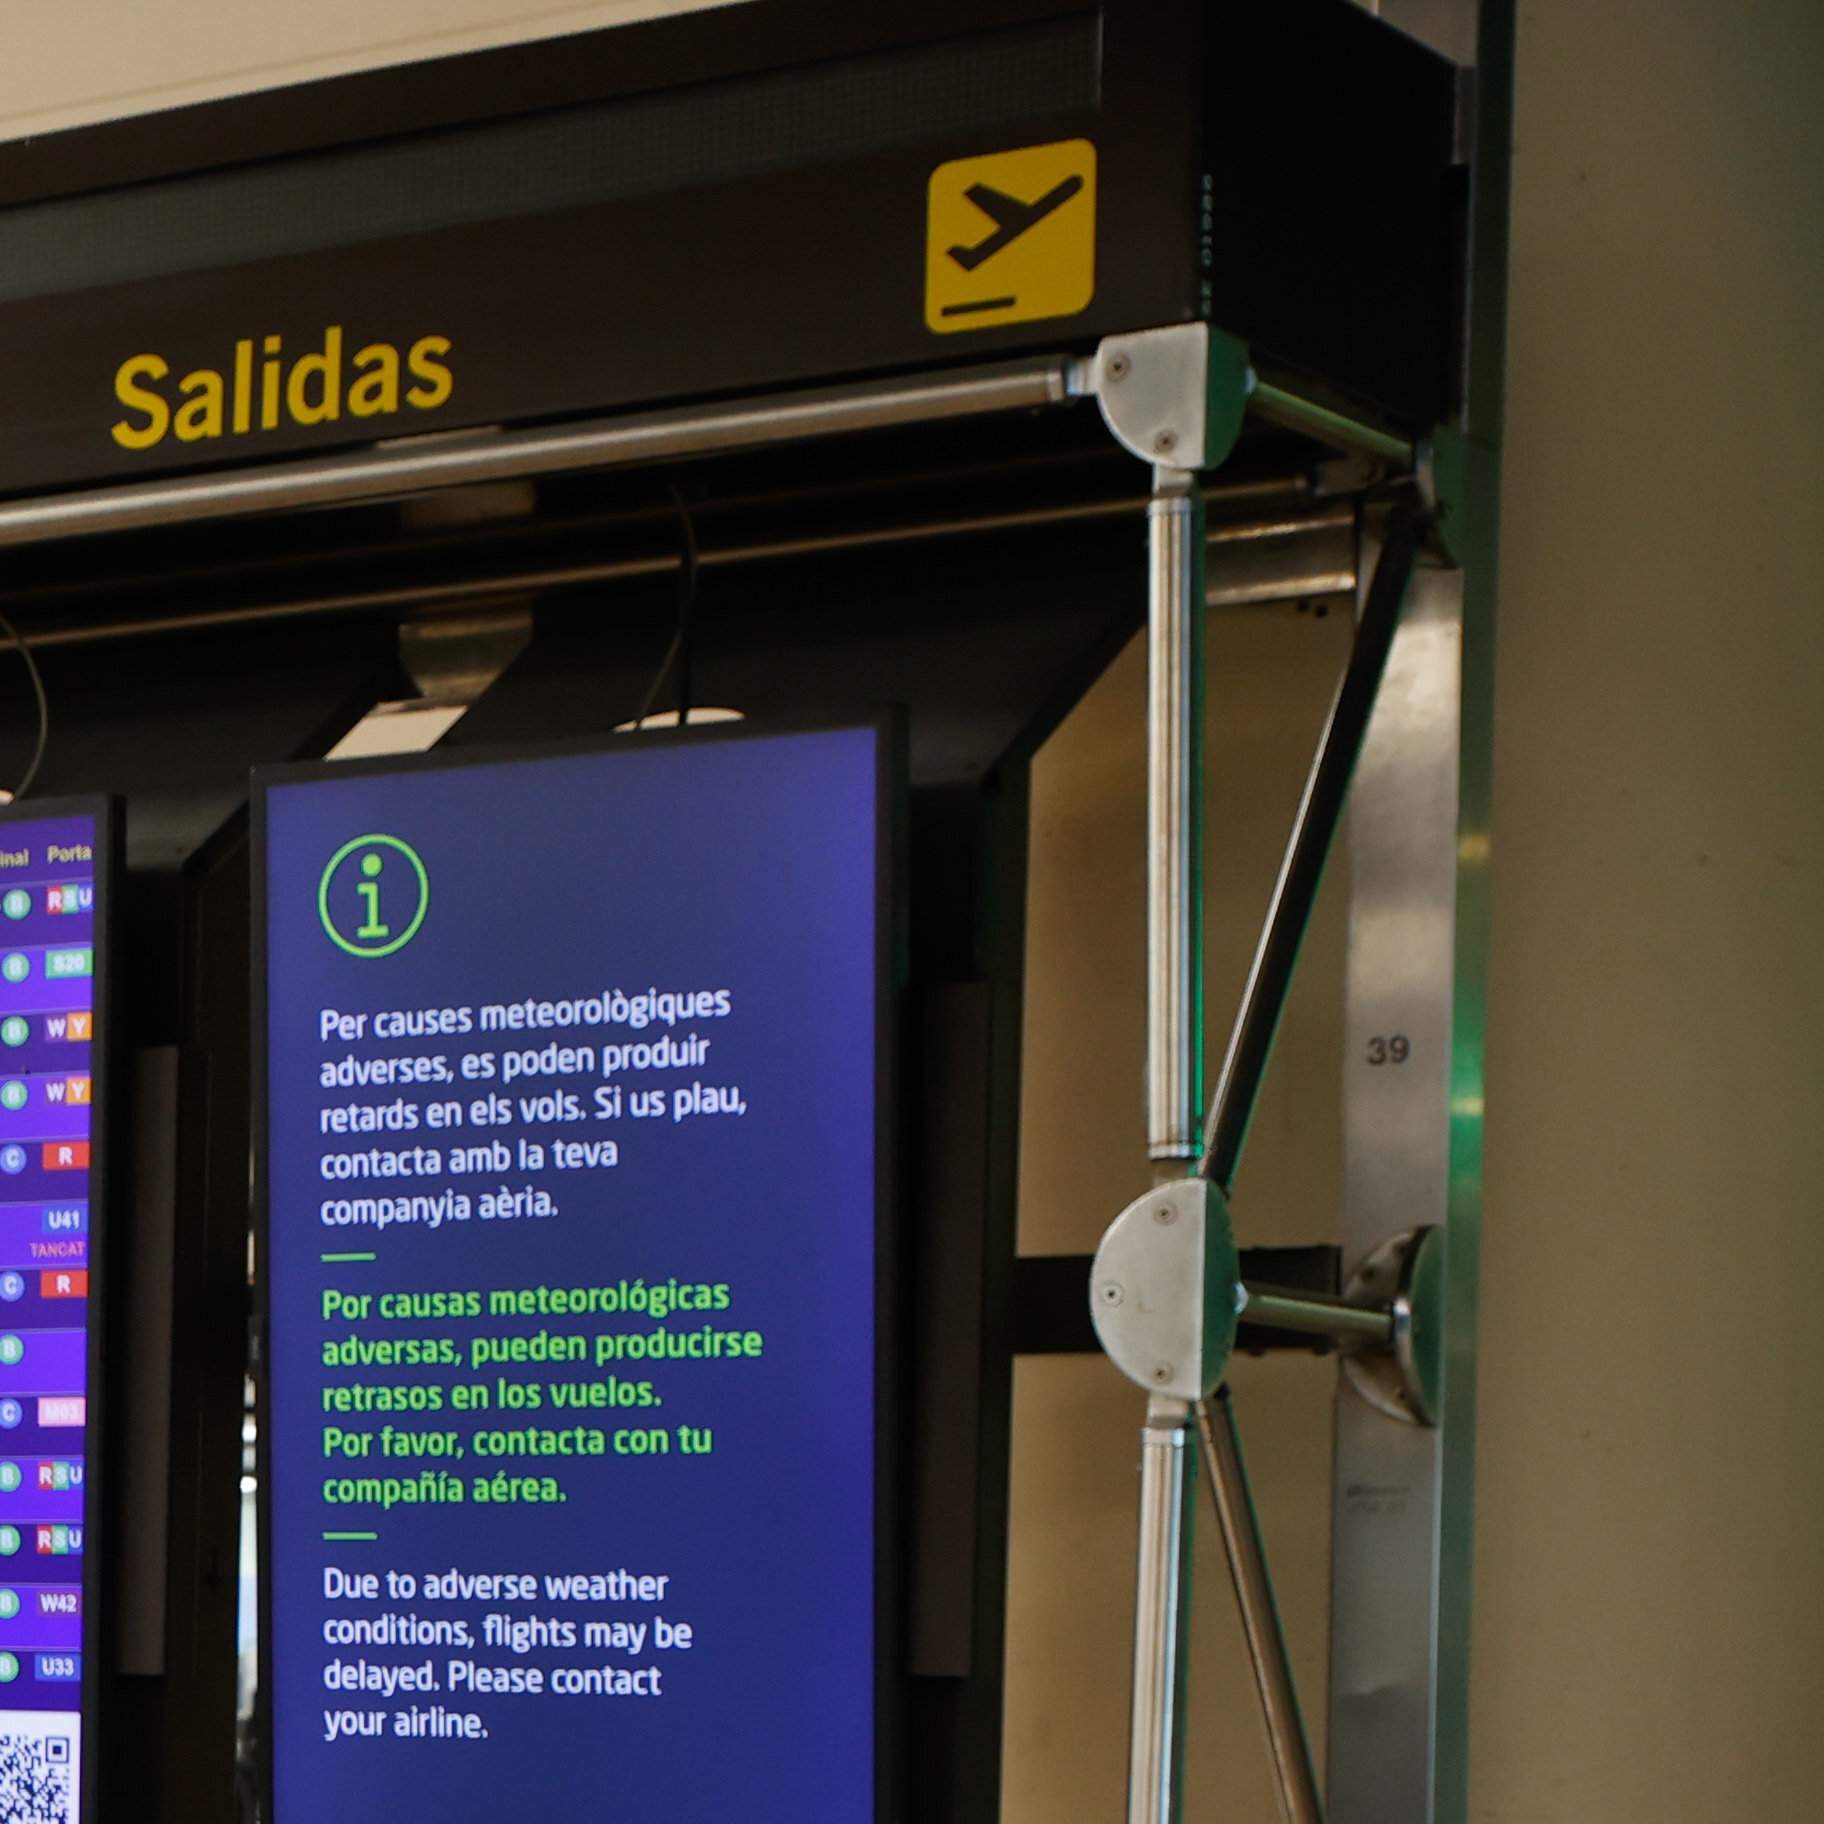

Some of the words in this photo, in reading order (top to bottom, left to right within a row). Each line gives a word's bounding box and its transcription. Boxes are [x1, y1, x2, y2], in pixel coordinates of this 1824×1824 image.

[112, 327, 457, 449] Salidas
[48, 845, 92, 863] Porta
[321, 1010, 367, 1041] Per
[375, 1007, 472, 1037] causes
[481, 987, 730, 1030] meteorològiques
[321, 1055, 453, 1087] adverses,
[462, 1053, 495, 1078] es
[504, 1042, 594, 1083] poden
[603, 1033, 710, 1078] produir
[1367, 1035, 1409, 1066] 39
[321, 1098, 418, 1133] retards
[427, 1102, 462, 1127] en
[470, 1093, 512, 1125] els
[520, 1089, 586, 1122] vols.
[595, 1086, 621, 1119] Si
[631, 1091, 665, 1117] us
[674, 1082, 746, 1122] plau,
[321, 1147, 441, 1179] contacta
[449, 1140, 510, 1173] amb
[519, 1139, 544, 1169] la
[552, 1140, 617, 1168] teva
[49, 1211, 79, 1229] U41
[321, 1189, 470, 1229] companyia
[479, 1185, 558, 1218] aèria.
[30, 1241, 85, 1257] TANCAT
[323, 1290, 372, 1320] Por
[380, 1292, 480, 1318] causas
[490, 1279, 729, 1317] meteorológicas
[323, 1335, 461, 1366] adversas,
[472, 1330, 586, 1369] pueden
[596, 1326, 762, 1365] producirse
[323, 1384, 442, 1411] retrasos
[452, 1386, 488, 1409] en
[499, 1378, 541, 1408] los
[550, 1376, 661, 1407] vuelos.
[324, 1428, 372, 1457] Por
[380, 1426, 464, 1459] favor,
[474, 1427, 604, 1455] contacta
[614, 1430, 668, 1454] con
[678, 1426, 711, 1453] tu
[324, 1471, 463, 1509] compañía
[473, 1471, 566, 1502] aérea.
[325, 1568, 378, 1598] Due
[386, 1571, 416, 1598] to
[424, 1568, 537, 1599] adverse
[545, 1569, 669, 1600] weather
[41, 1594, 76, 1612] W42
[324, 1613, 474, 1648] conditions,
[482, 1614, 576, 1653] flights
[585, 1623, 646, 1654] may
[655, 1616, 692, 1648] be
[42, 1657, 74, 1676] U33
[324, 1659, 439, 1696] delayed.
[449, 1661, 543, 1693] Please
[552, 1666, 661, 1695] contact
[325, 1711, 386, 1741] your
[394, 1706, 488, 1738] airline.
